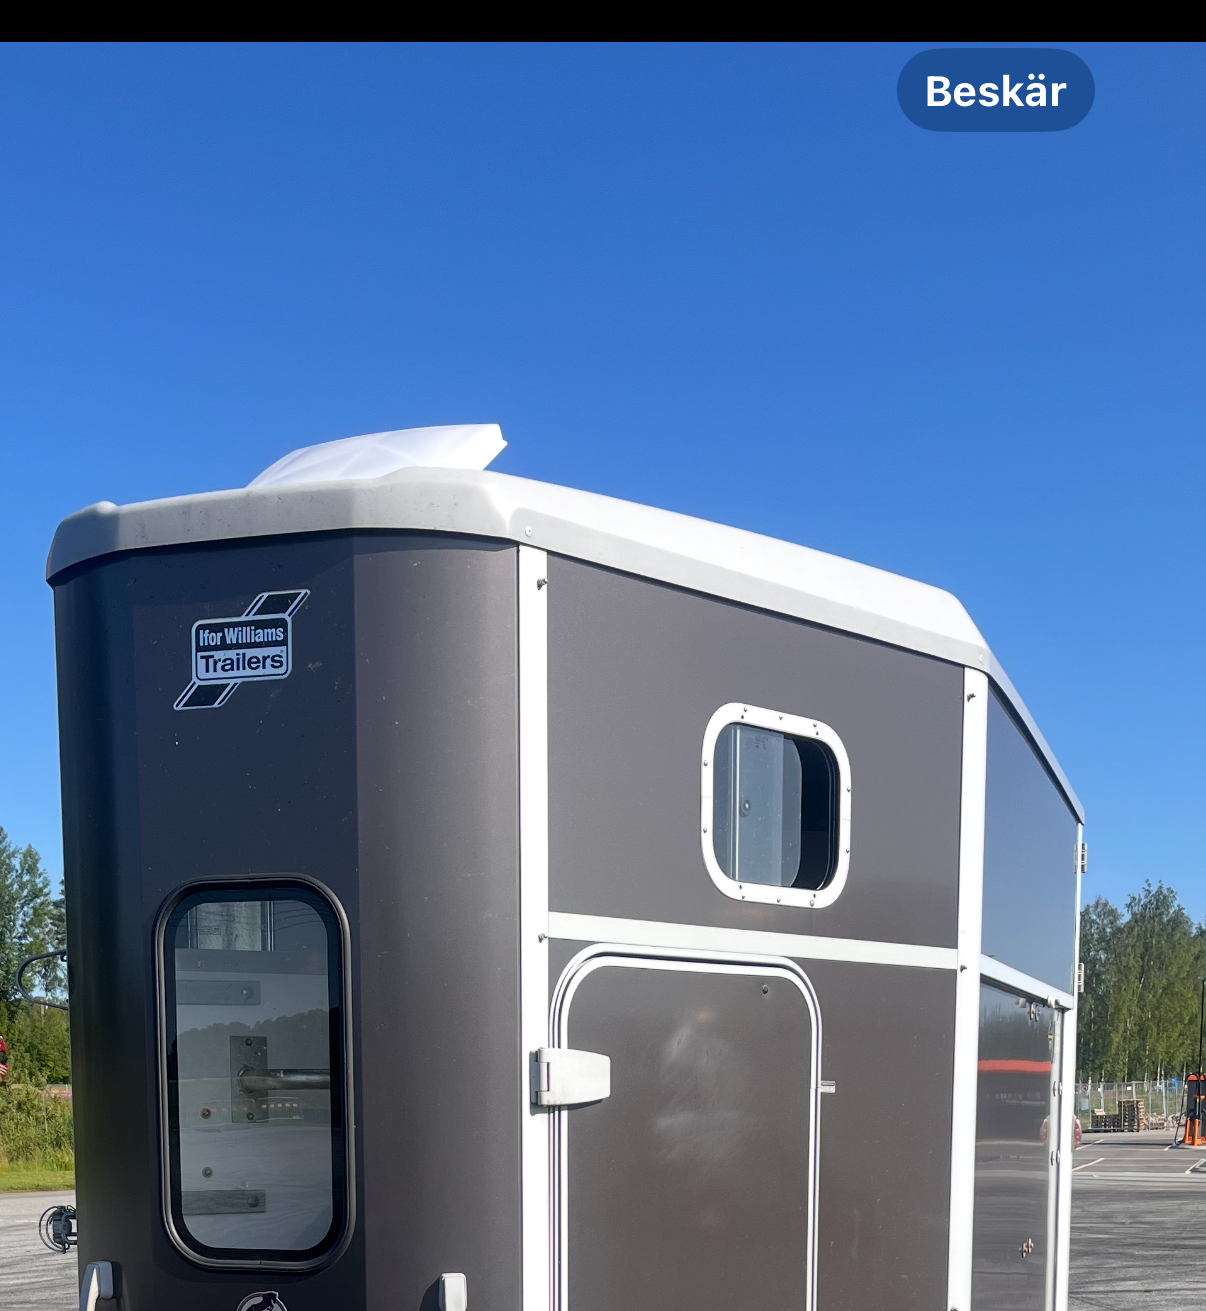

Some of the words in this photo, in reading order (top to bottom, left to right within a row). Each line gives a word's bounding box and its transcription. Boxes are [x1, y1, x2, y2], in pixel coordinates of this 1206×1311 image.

[200, 629, 223, 647] Ifor
[224, 626, 284, 644] Williams
[200, 653, 284, 673] Trailers
